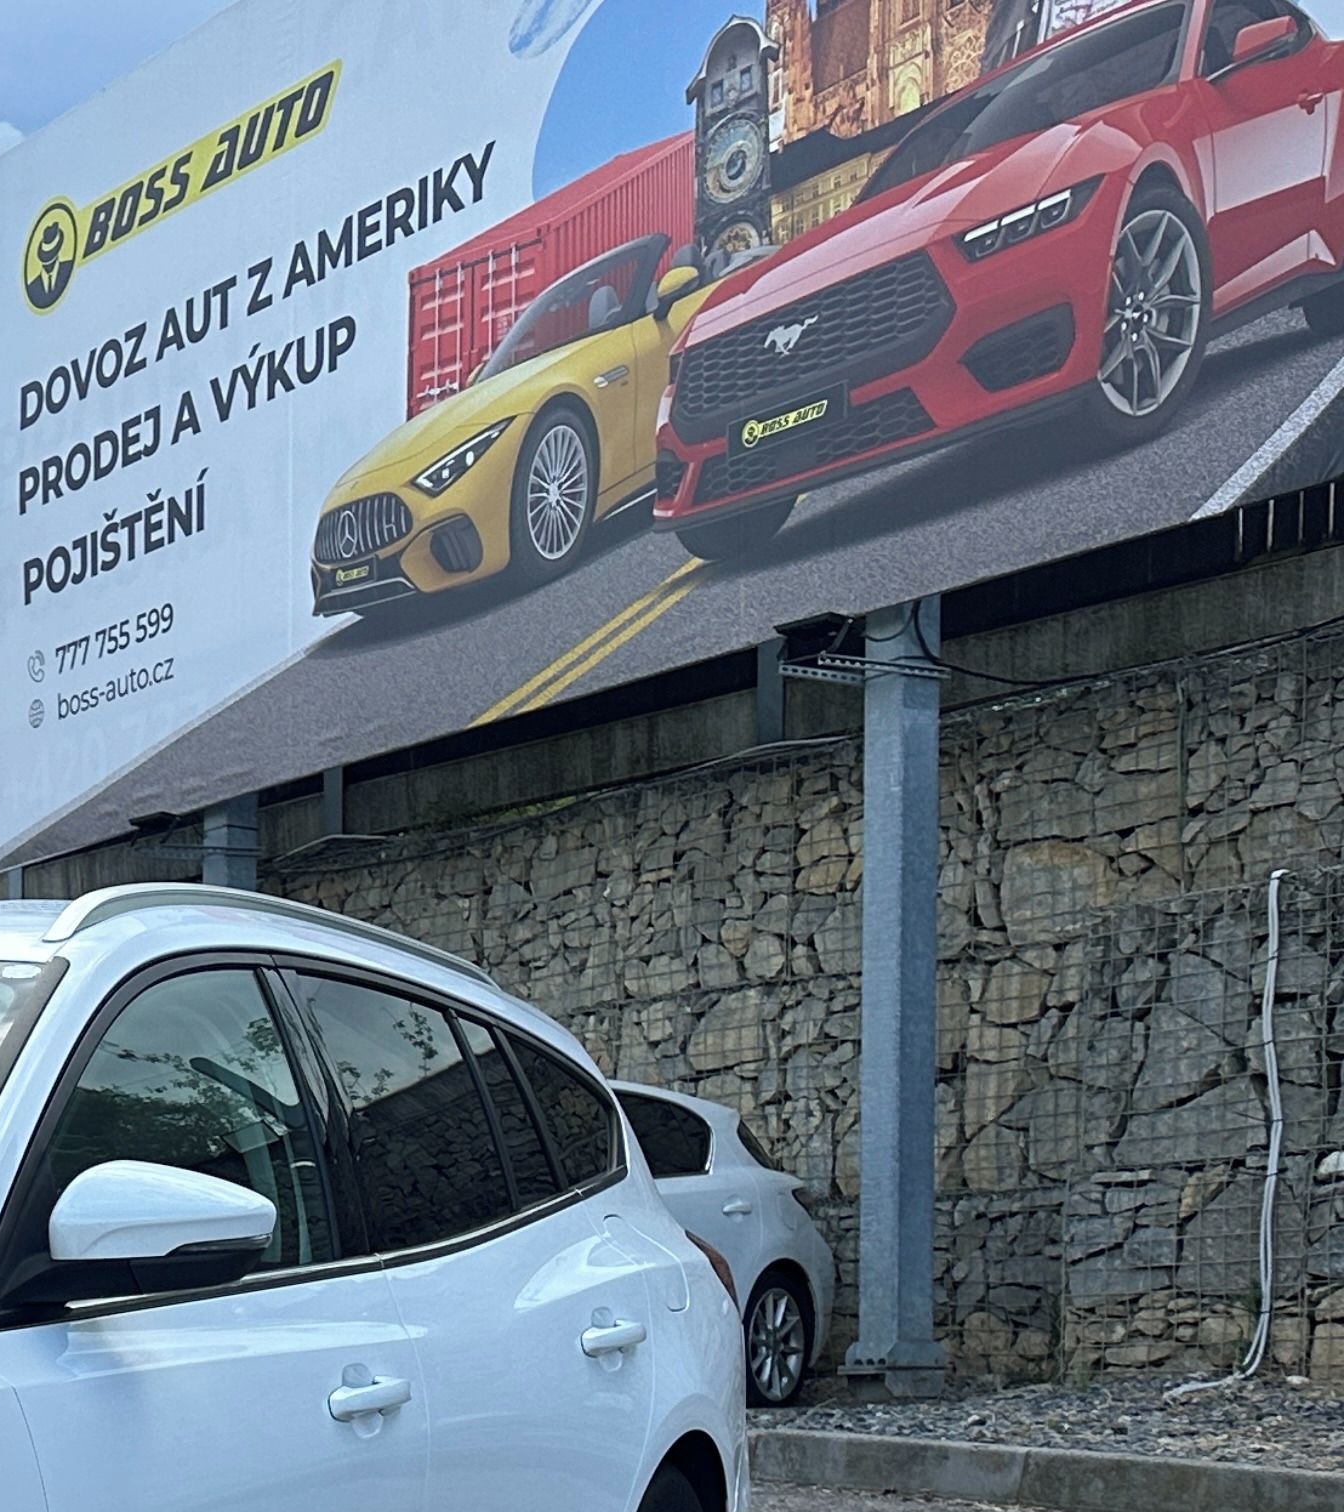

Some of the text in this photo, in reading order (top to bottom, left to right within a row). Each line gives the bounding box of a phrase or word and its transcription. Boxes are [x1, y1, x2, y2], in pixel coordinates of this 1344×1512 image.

[82, 71, 335, 260] BOSS AUTO
[20, 140, 496, 430] DOVOZ AUT Z AMERIKY
[19, 315, 356, 515] PRODEJ A VÝKUP
[792, 403, 826, 423] AUTO
[24, 467, 210, 605] POJIŠTĚNÍ
[55, 603, 174, 674] 777 755 599
[57, 657, 175, 720] boss-auto.cz
